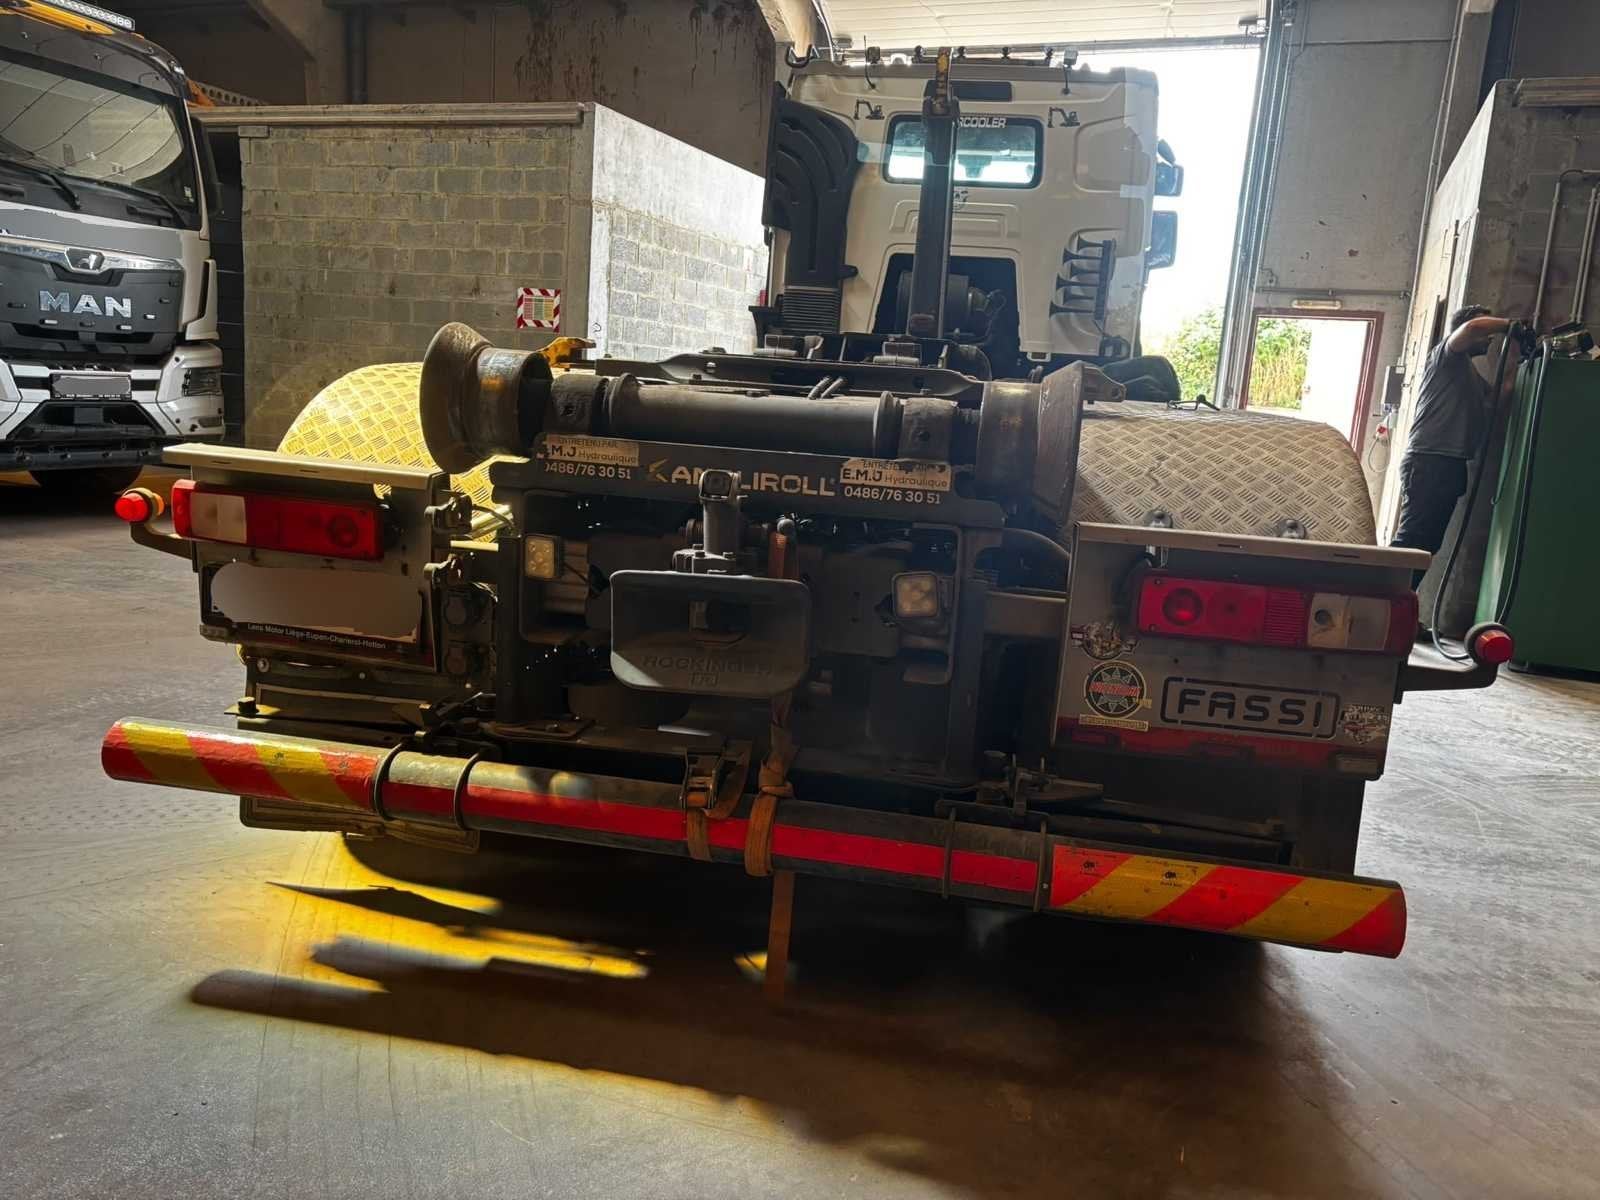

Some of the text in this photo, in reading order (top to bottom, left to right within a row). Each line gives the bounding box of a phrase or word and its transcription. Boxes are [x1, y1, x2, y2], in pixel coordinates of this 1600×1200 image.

[959, 117, 1006, 128] RCOOLER
[39, 290, 132, 319] MAN
[551, 445, 577, 457] M.J
[598, 465, 615, 478] 30
[618, 467, 631, 479] 51
[842, 468, 948, 488] E.M.J Hydraulique
[844, 486, 941, 504] 0486/76 30 51
[1177, 688, 1322, 728] FASSI
